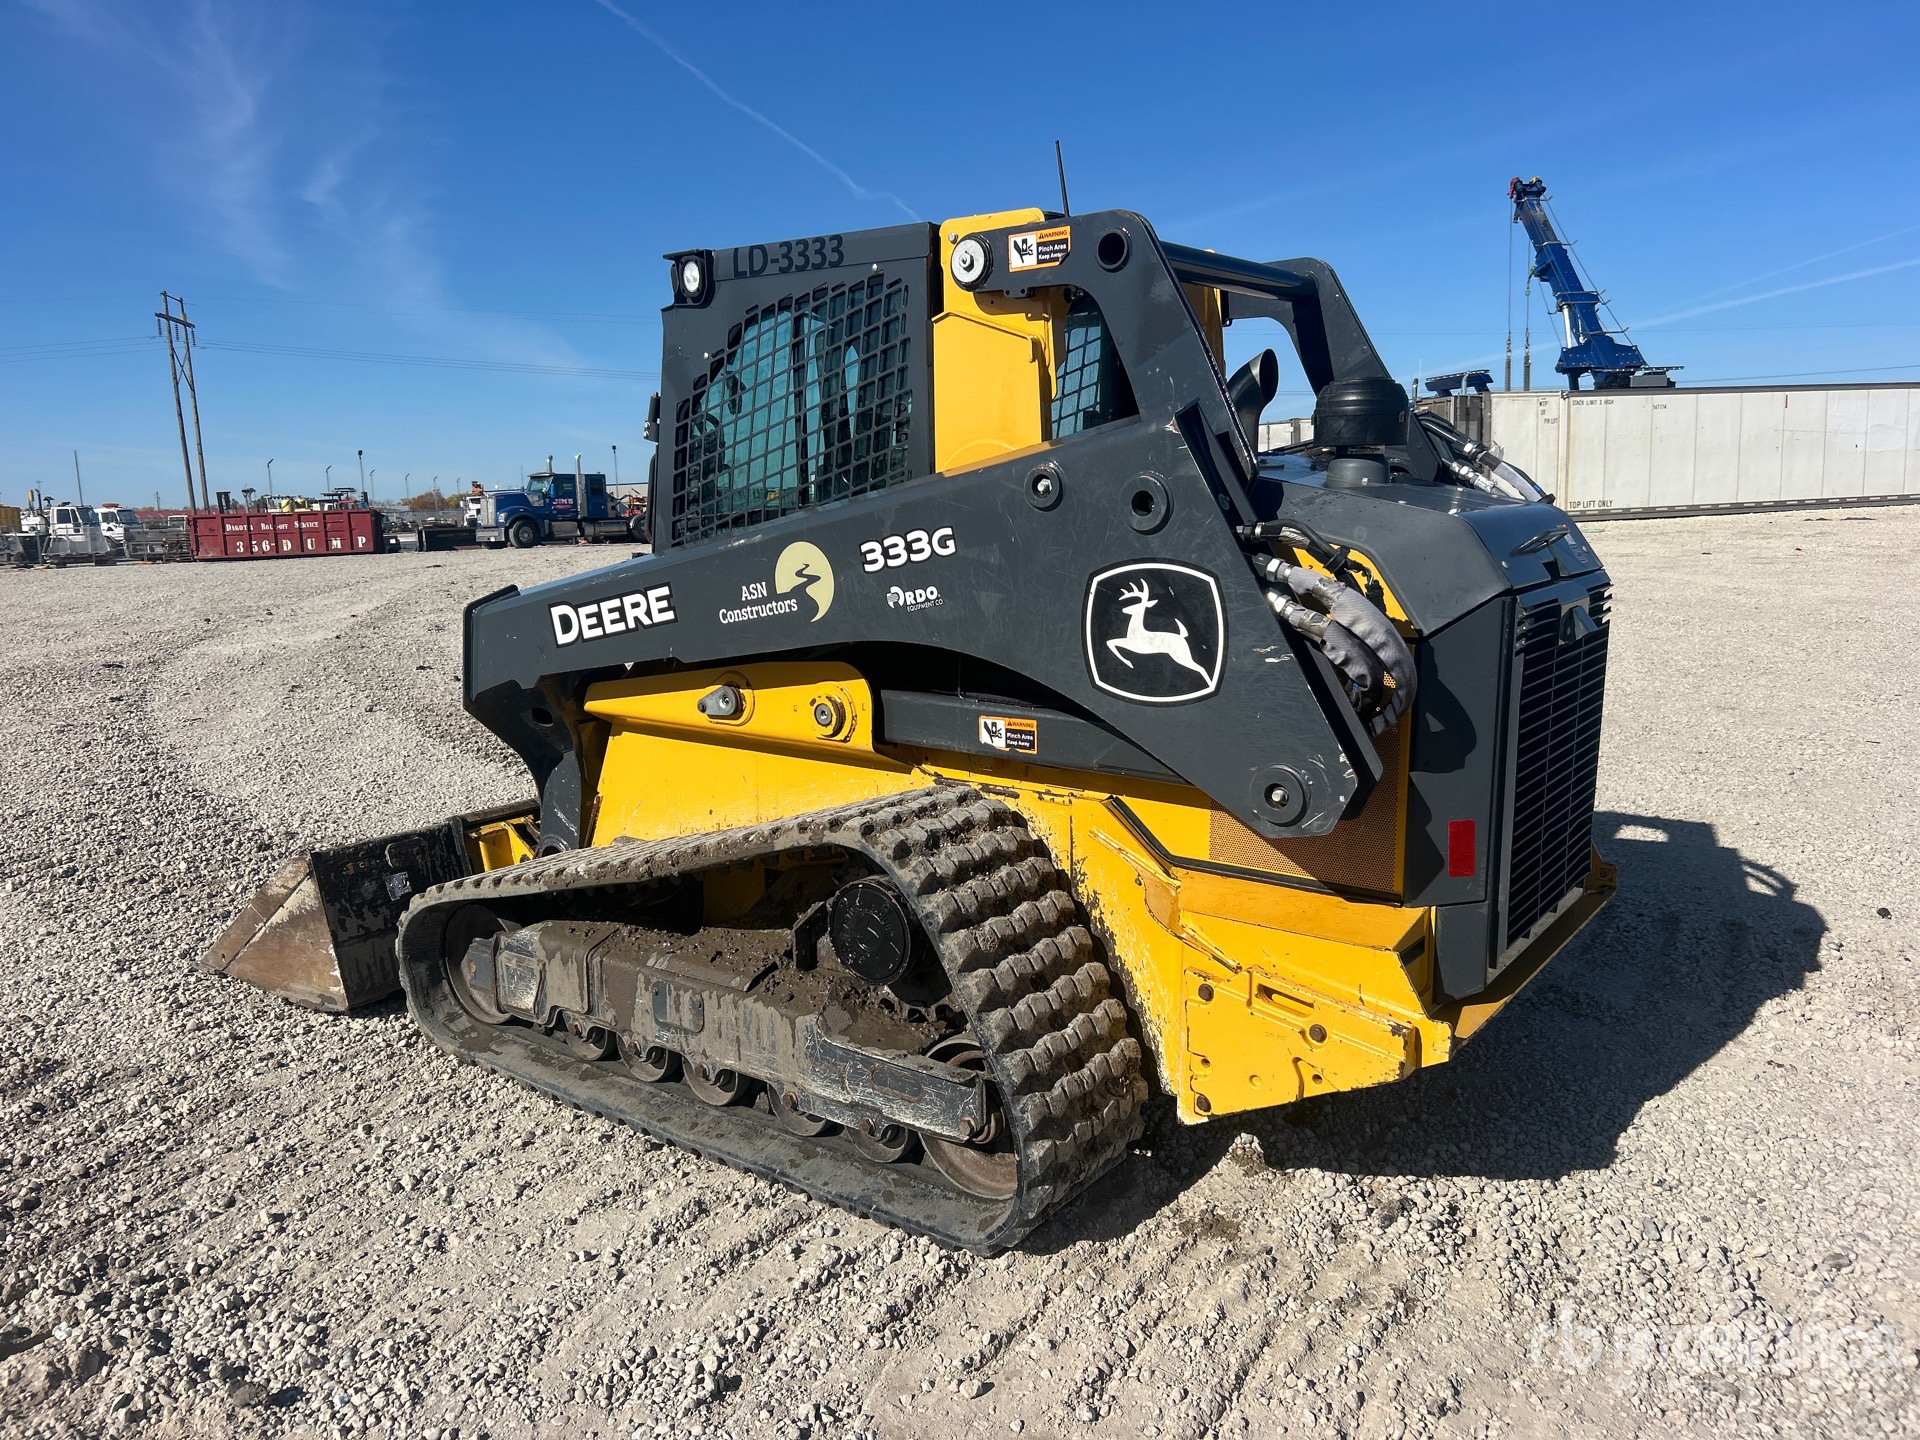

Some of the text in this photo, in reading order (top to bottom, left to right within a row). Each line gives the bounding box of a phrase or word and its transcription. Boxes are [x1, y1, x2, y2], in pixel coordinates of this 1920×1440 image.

[1043, 230, 1068, 238] WARNING
[733, 235, 844, 277] LD-3333
[1039, 243, 1066, 253] Pinch Area
[1569, 500, 1613, 509] TOP LIFT ONLY
[860, 527, 956, 572] 333G
[741, 582, 768, 600] ASN
[719, 598, 798, 624] Constructors
[907, 598, 944, 612] EQUIPMENT CO
[552, 585, 675, 645] DEERE
